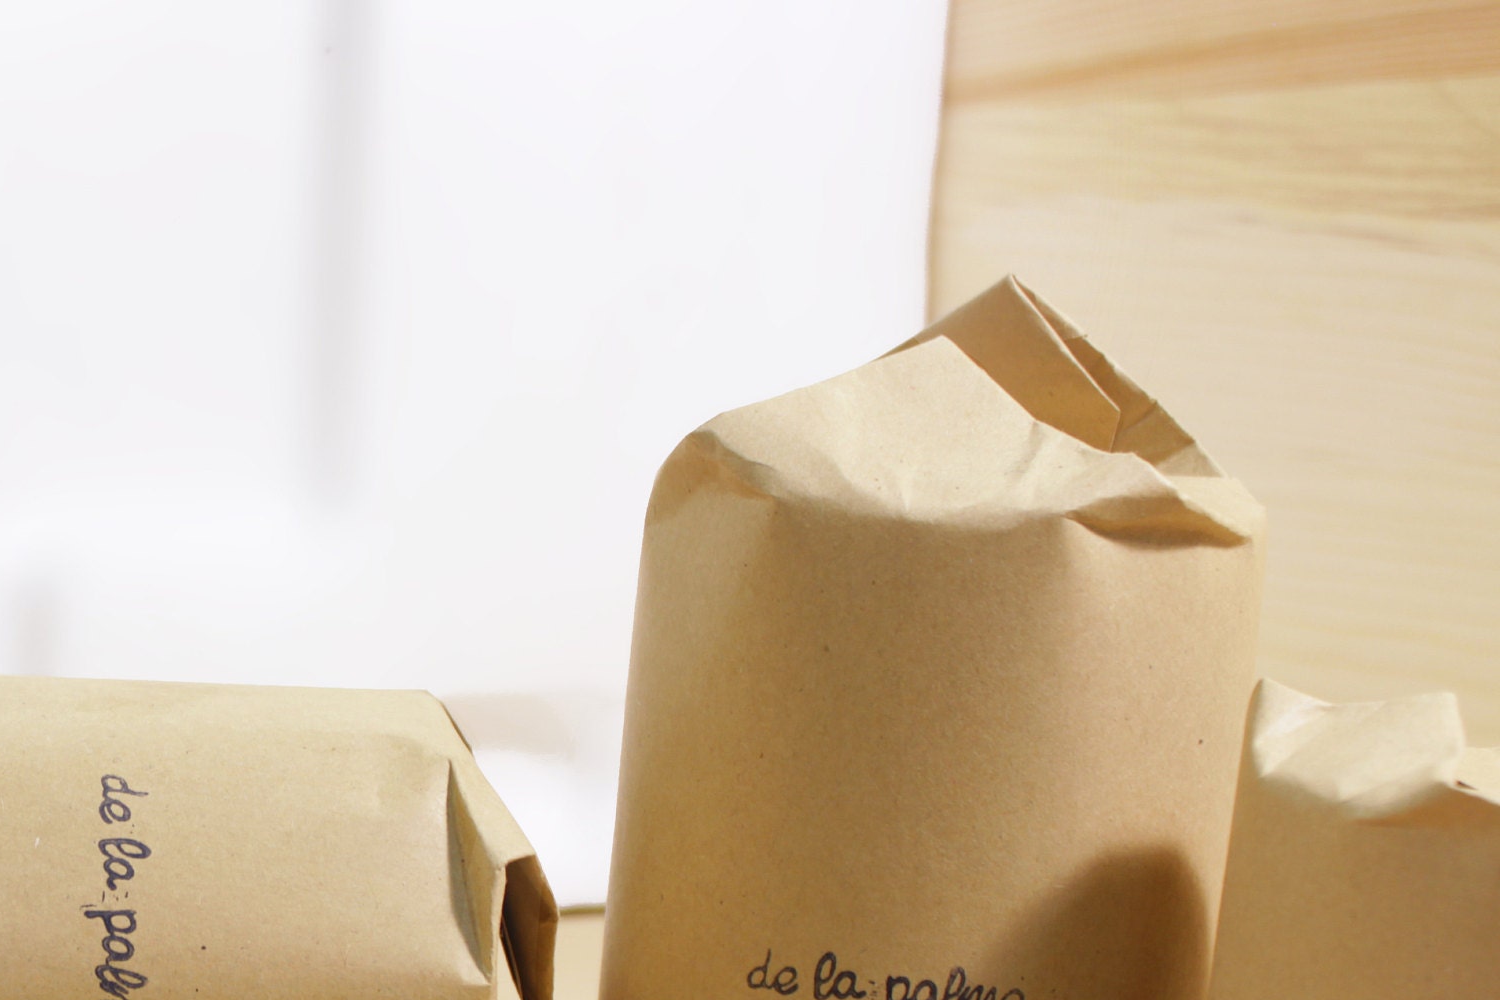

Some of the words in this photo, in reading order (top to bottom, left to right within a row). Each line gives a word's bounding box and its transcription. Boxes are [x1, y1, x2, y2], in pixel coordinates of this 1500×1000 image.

[98, 774, 149, 825] de
[98, 838, 152, 891] la
[747, 948, 799, 996] de
[813, 951, 868, 1000] la
